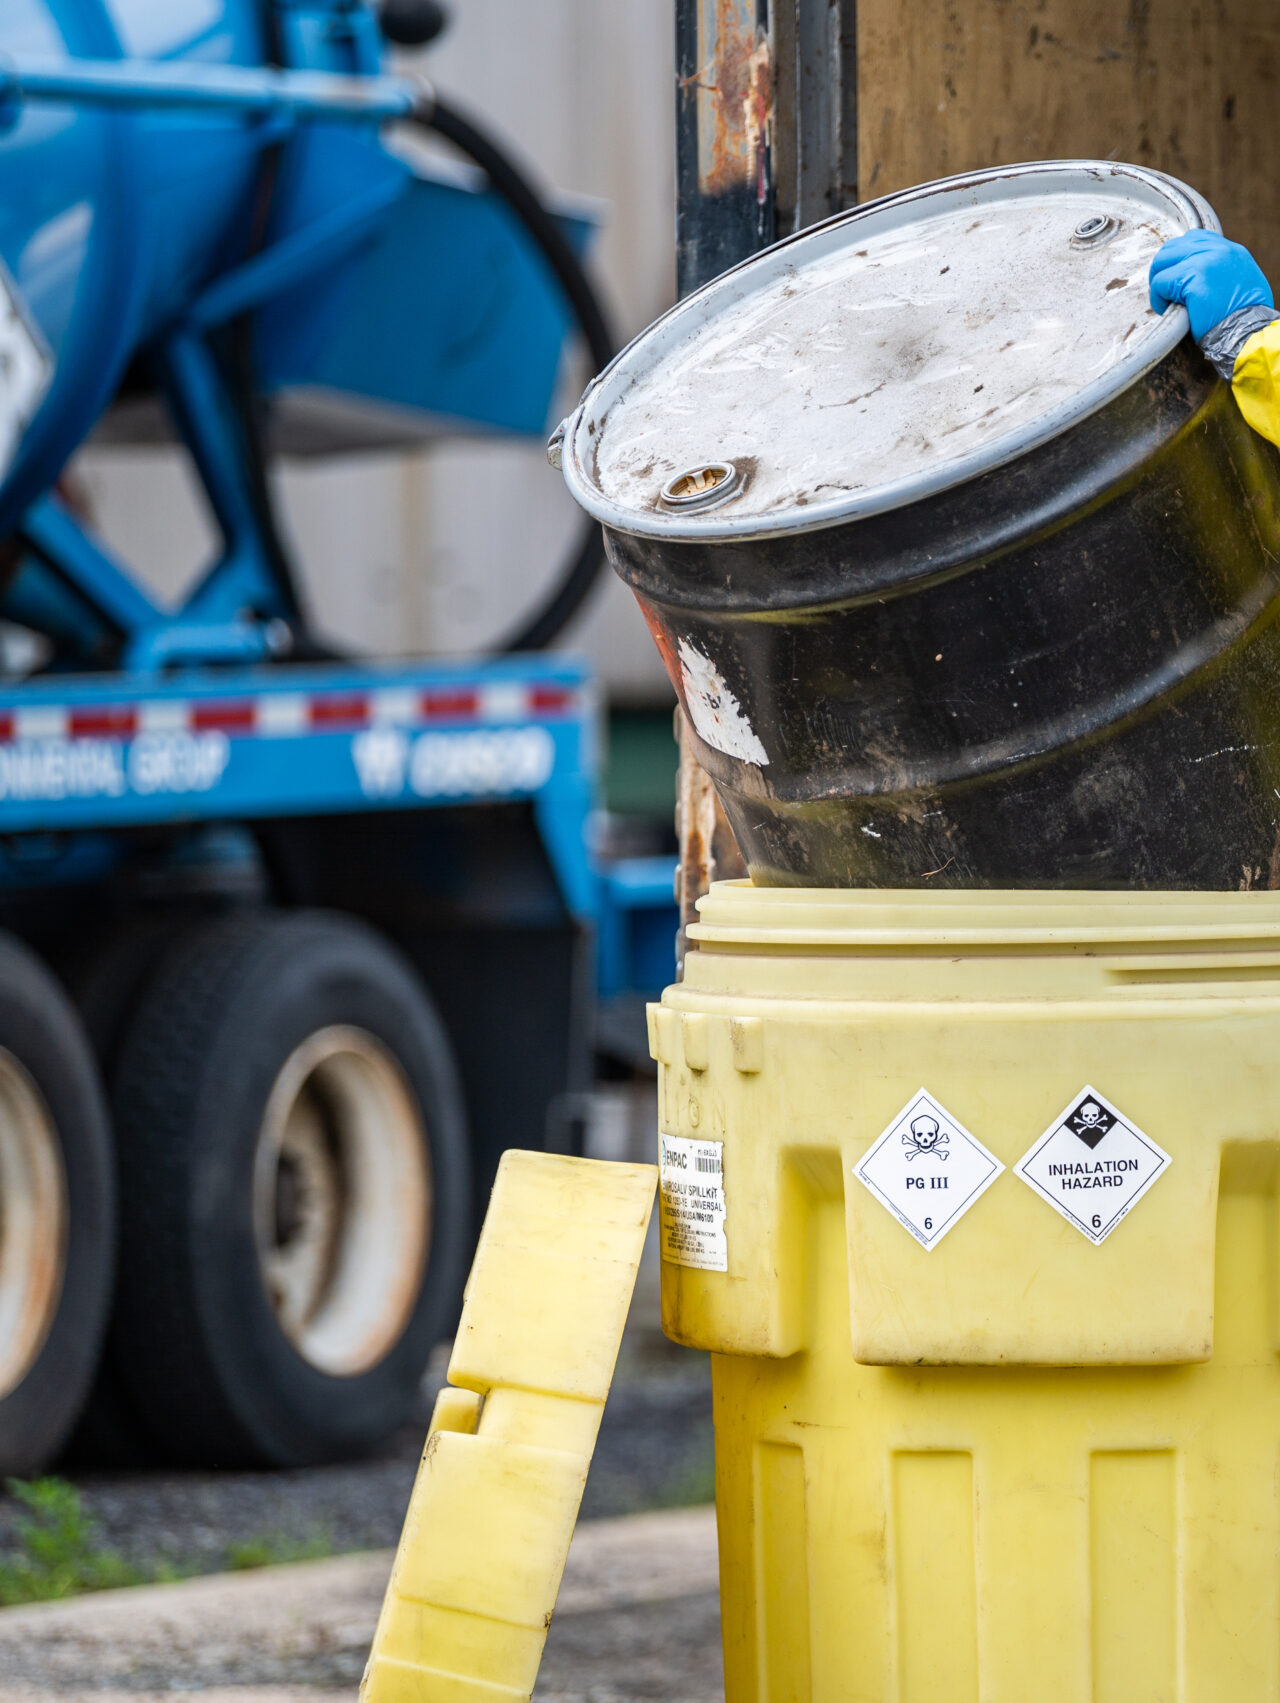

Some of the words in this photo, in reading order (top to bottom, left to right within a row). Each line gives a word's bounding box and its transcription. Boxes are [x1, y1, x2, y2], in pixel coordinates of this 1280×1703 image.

[666, 1150, 688, 1170] ENPAC
[1048, 1159, 1139, 1177] INHALATION
[906, 1177, 925, 1190] PG
[930, 1176, 949, 1189] III
[1061, 1175, 1124, 1190] HAZARD
[691, 1200, 723, 1212] UNIVERSAL
[924, 1217, 933, 1230] 6
[1091, 1214, 1102, 1229] 6
